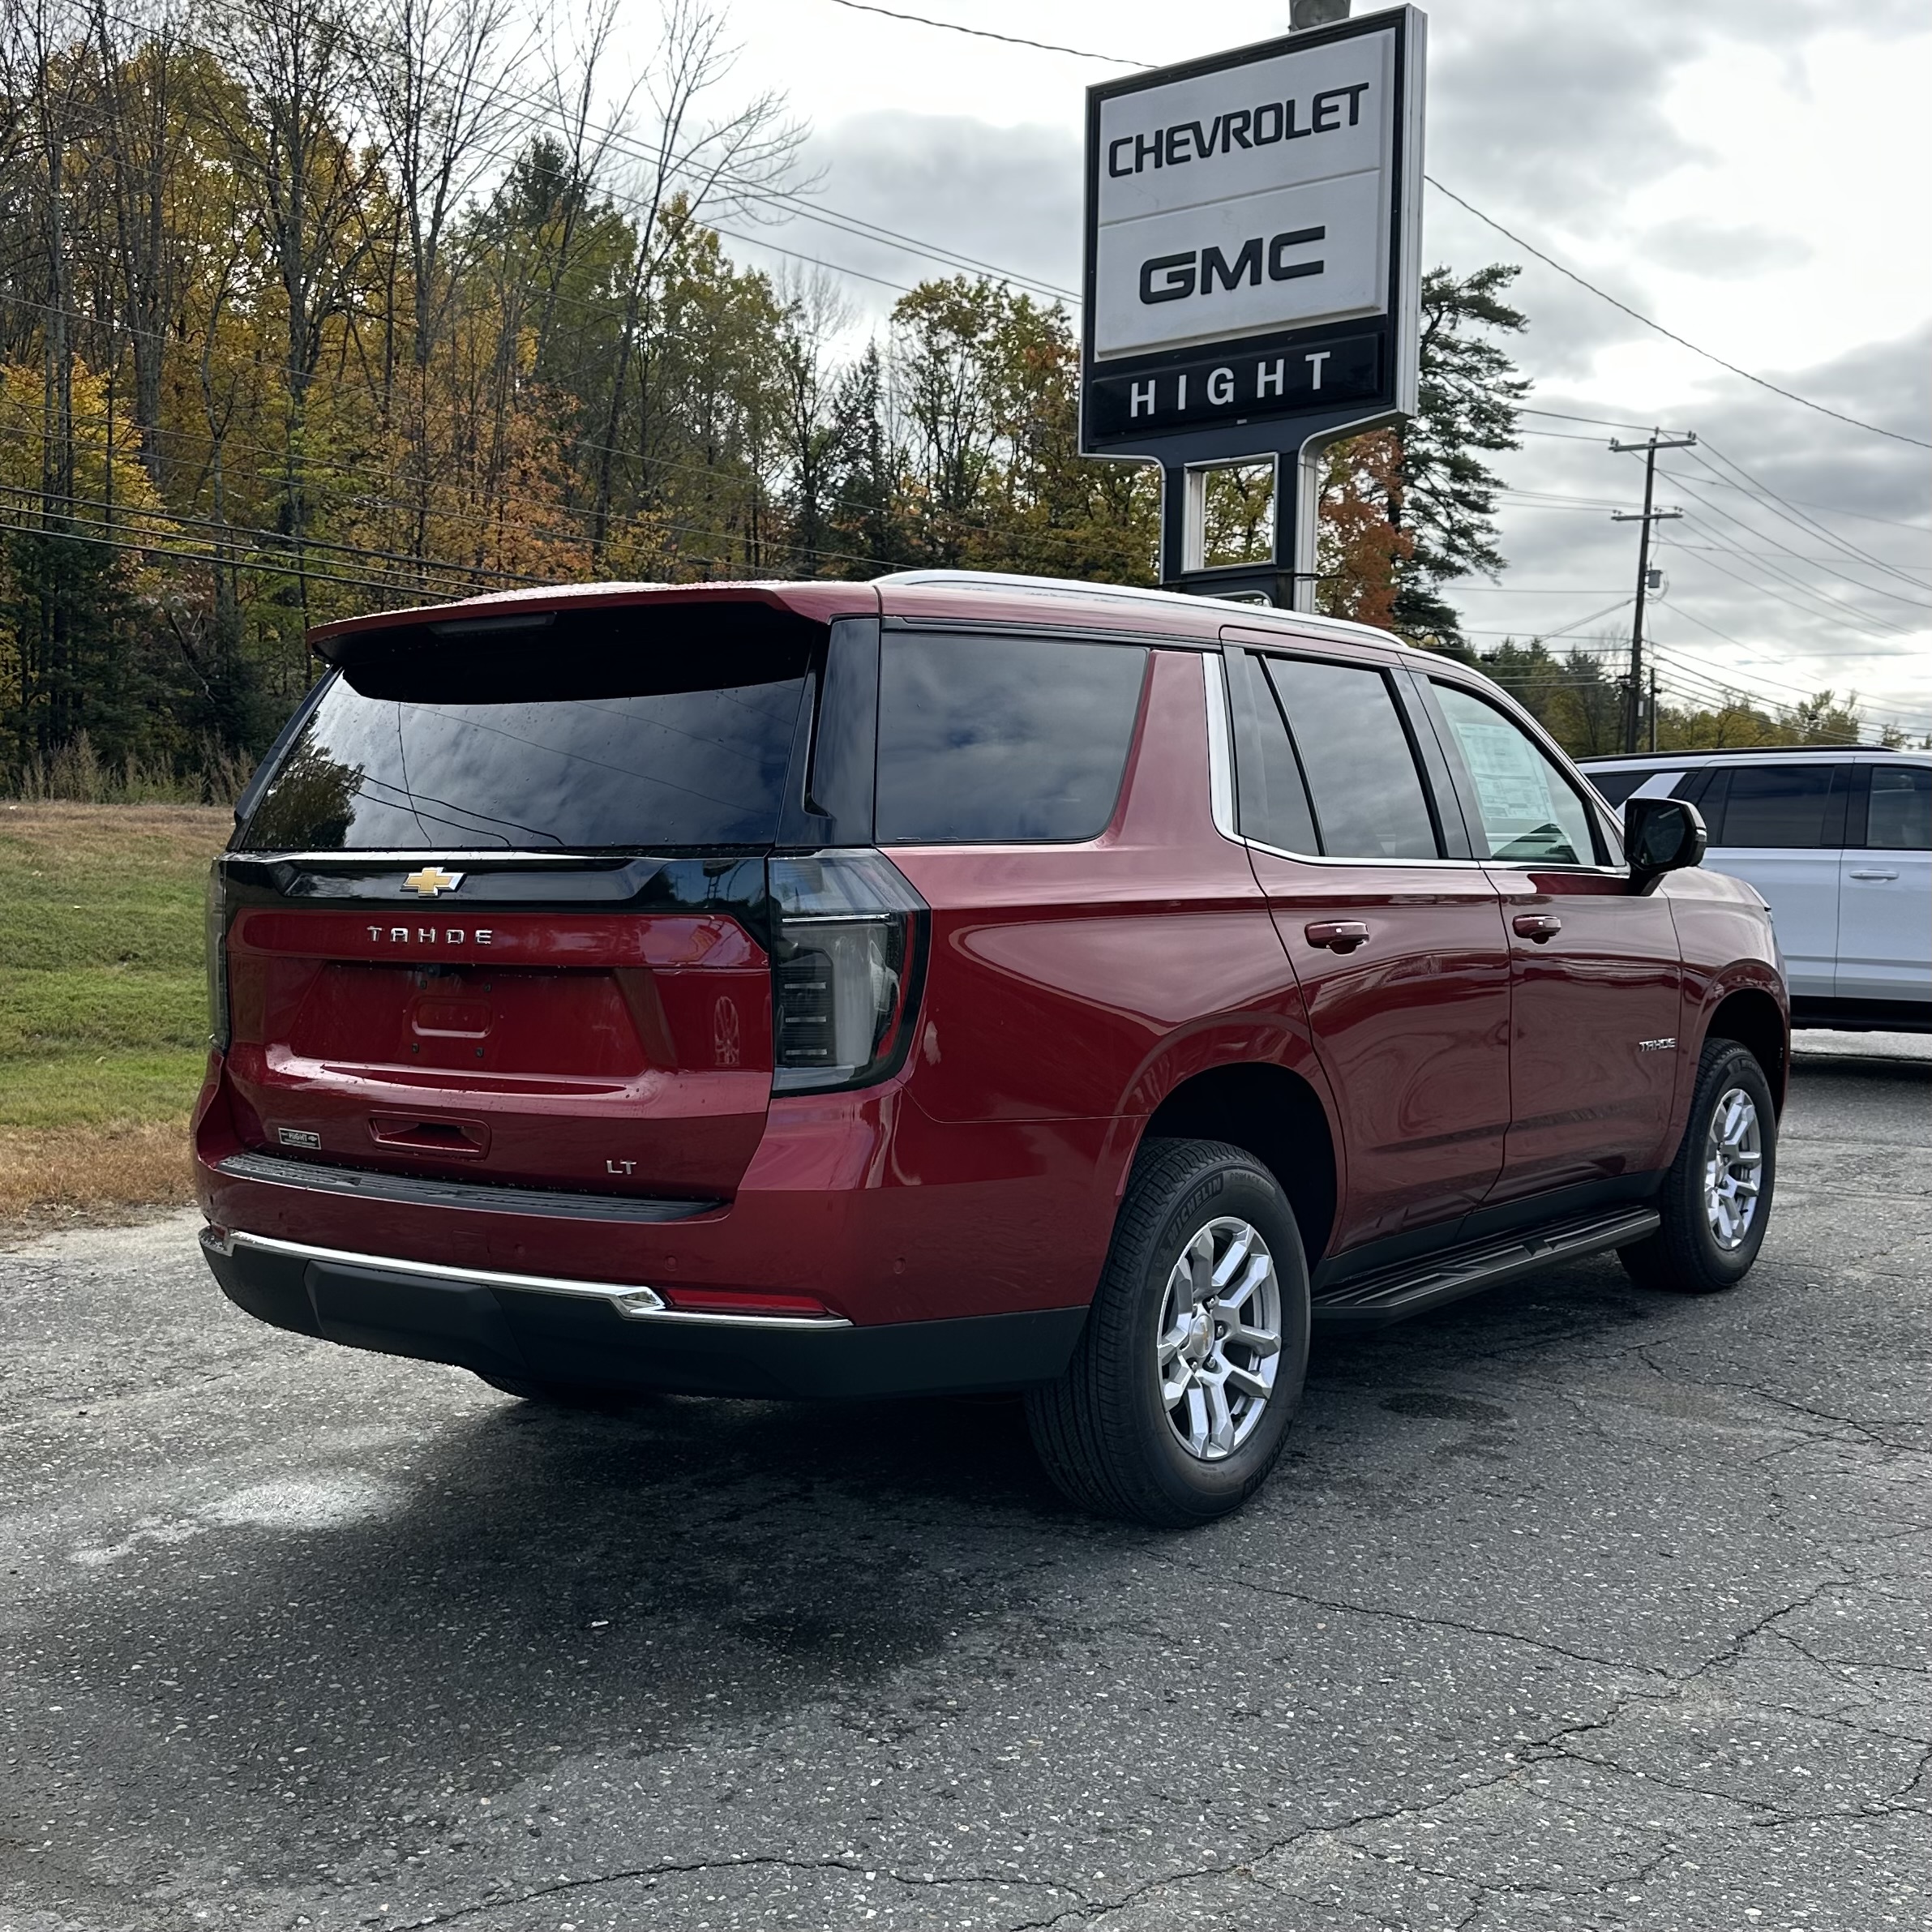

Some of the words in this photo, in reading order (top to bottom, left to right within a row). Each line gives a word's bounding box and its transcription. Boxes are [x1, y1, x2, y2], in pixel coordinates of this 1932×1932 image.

[1108, 82, 1369, 178] CHEVROLET
[1139, 225, 1326, 305] GMC
[1130, 351, 1330, 418] HIGHT
[366, 926, 493, 945] TAHOE
[1639, 1038, 1676, 1052] TAHOE
[606, 1159, 637, 1175] LT
[1167, 1176, 1222, 1245] MICHELIN
